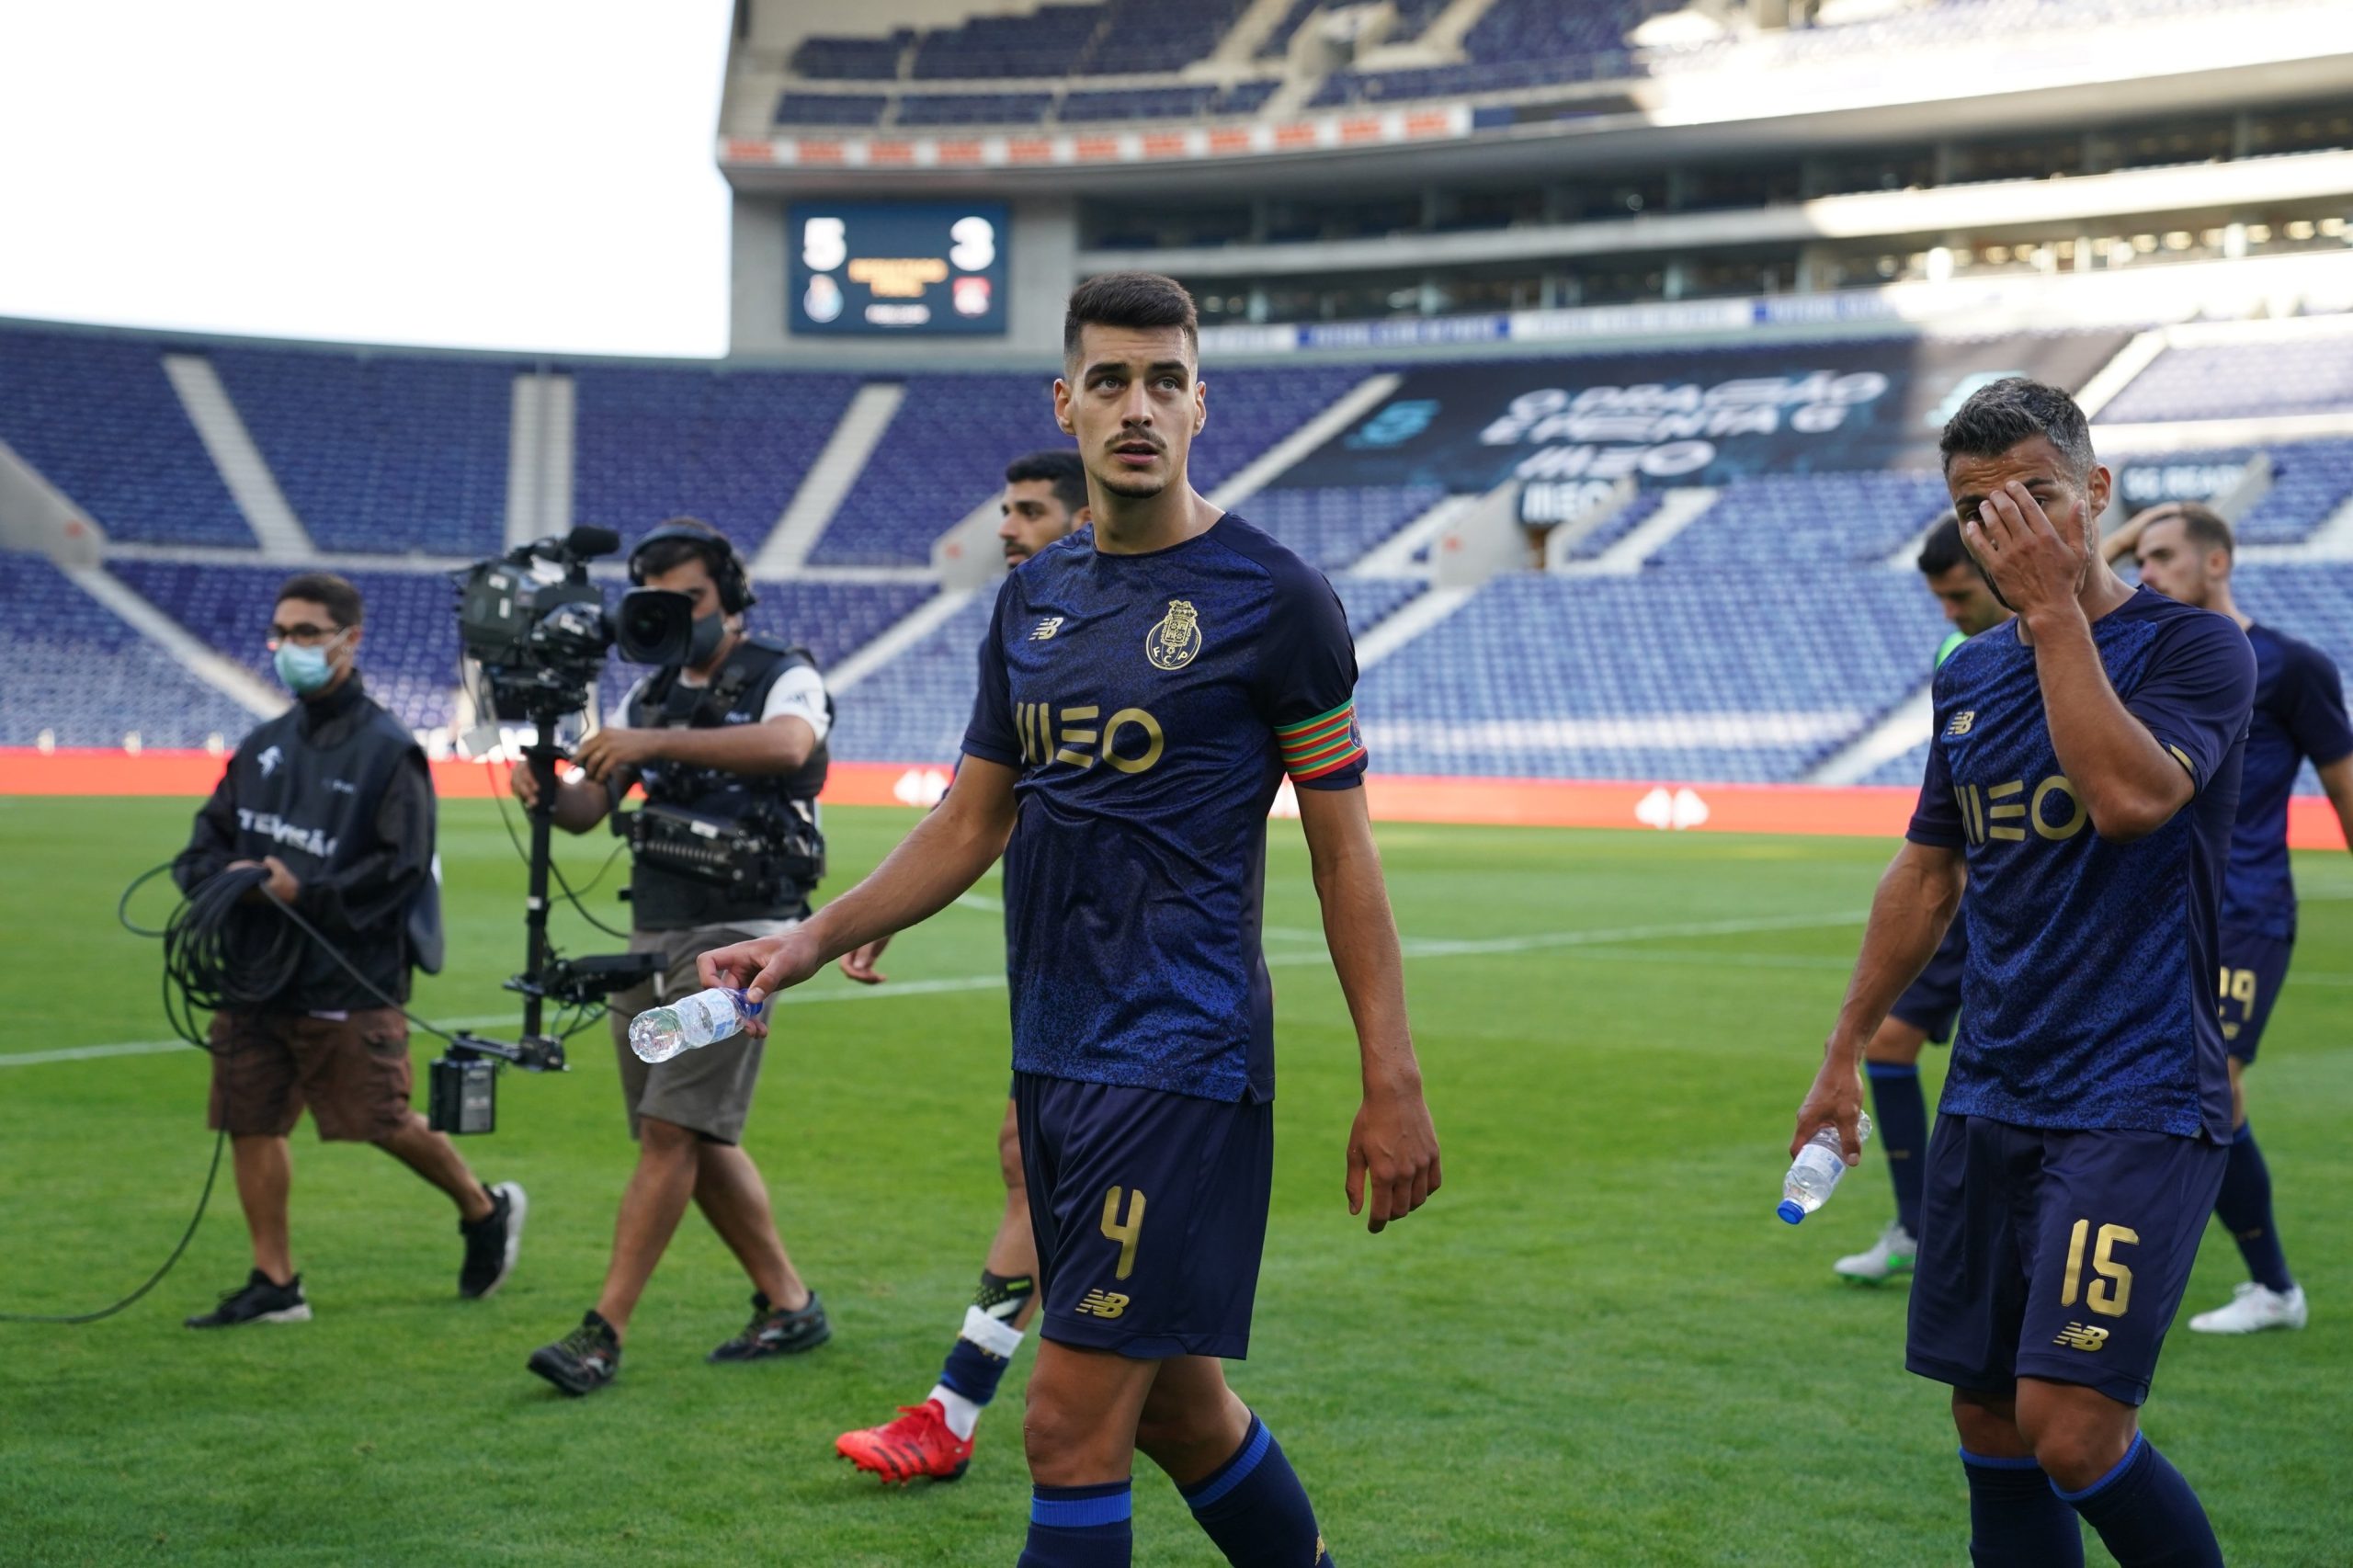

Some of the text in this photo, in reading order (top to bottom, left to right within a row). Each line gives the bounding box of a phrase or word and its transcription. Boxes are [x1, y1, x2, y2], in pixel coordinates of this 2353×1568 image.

[802, 216, 995, 271] 5 3
[1016, 701, 1165, 774] MEO
[1954, 775, 2088, 845] MEO
[1100, 1185, 1147, 1281] 4
[2061, 1219, 2140, 1318] 15
